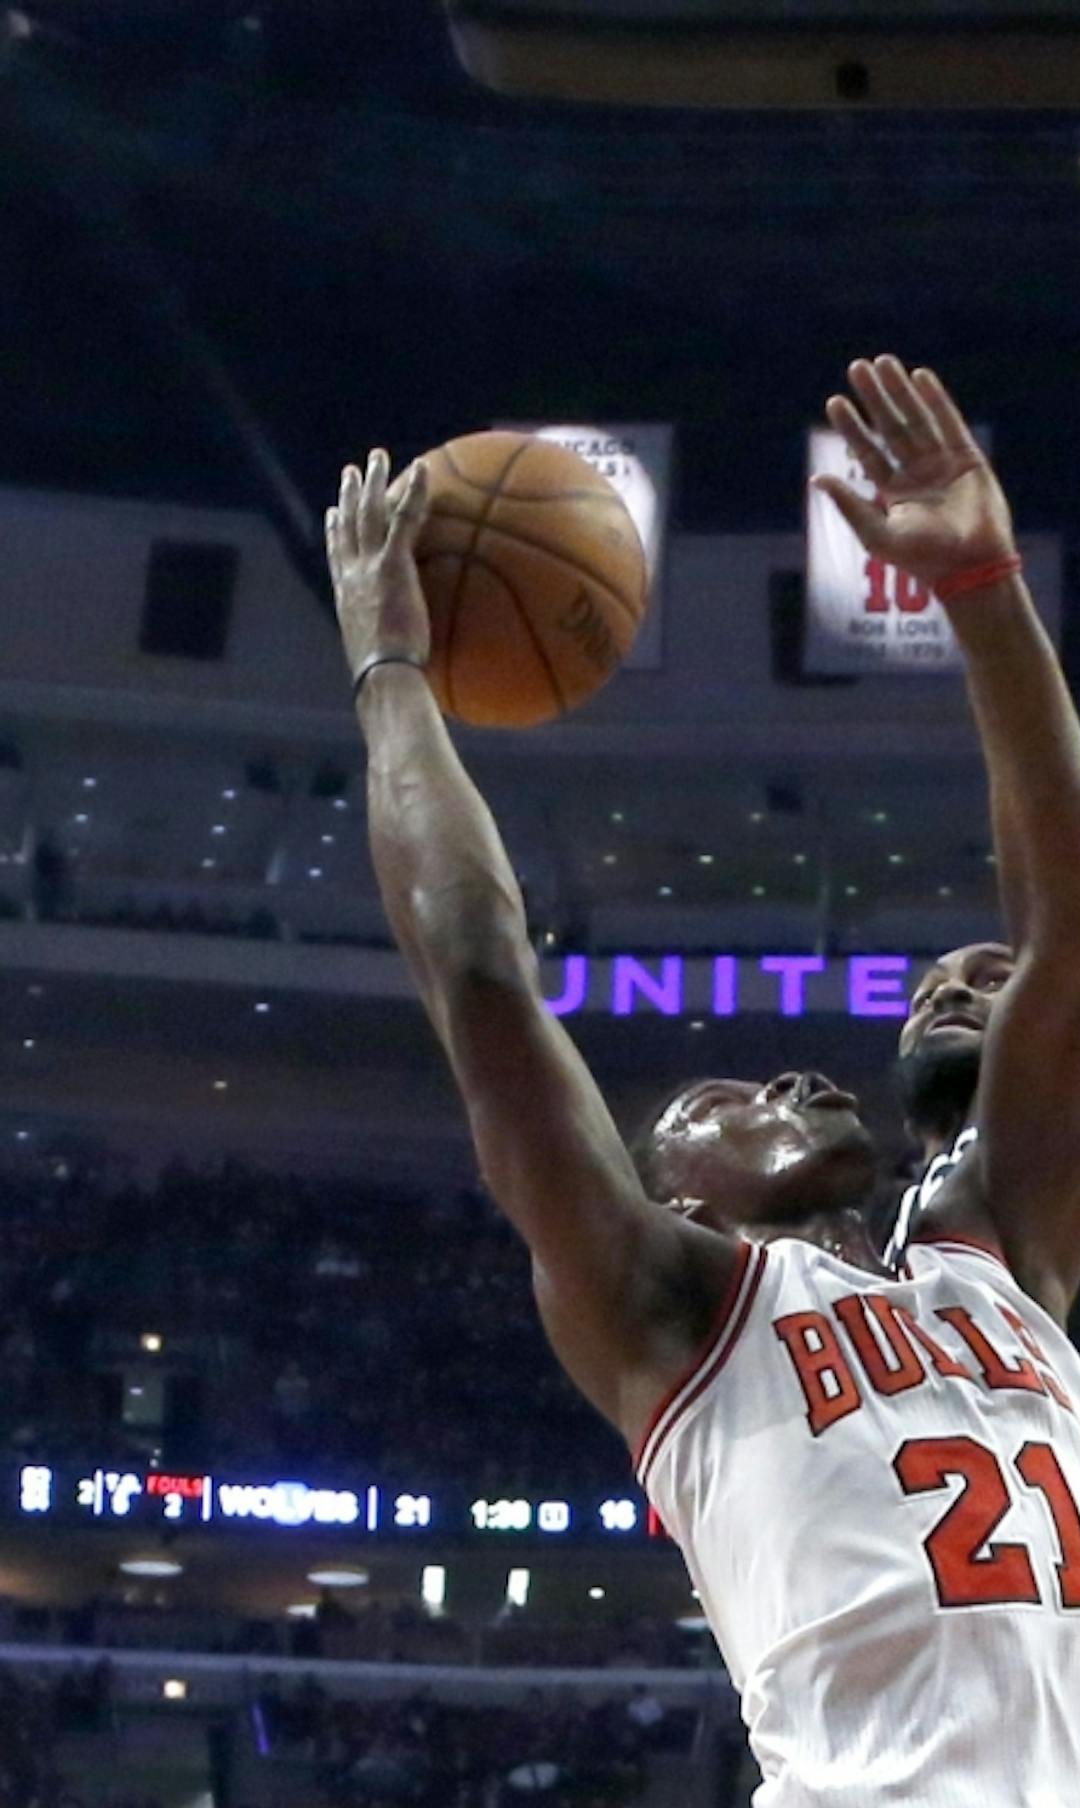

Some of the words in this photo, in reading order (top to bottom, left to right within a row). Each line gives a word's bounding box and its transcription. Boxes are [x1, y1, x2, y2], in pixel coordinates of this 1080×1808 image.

[545, 955, 908, 1015] UNITE
[219, 1484, 358, 1525] WOLVES
[395, 1495, 430, 1526] 21
